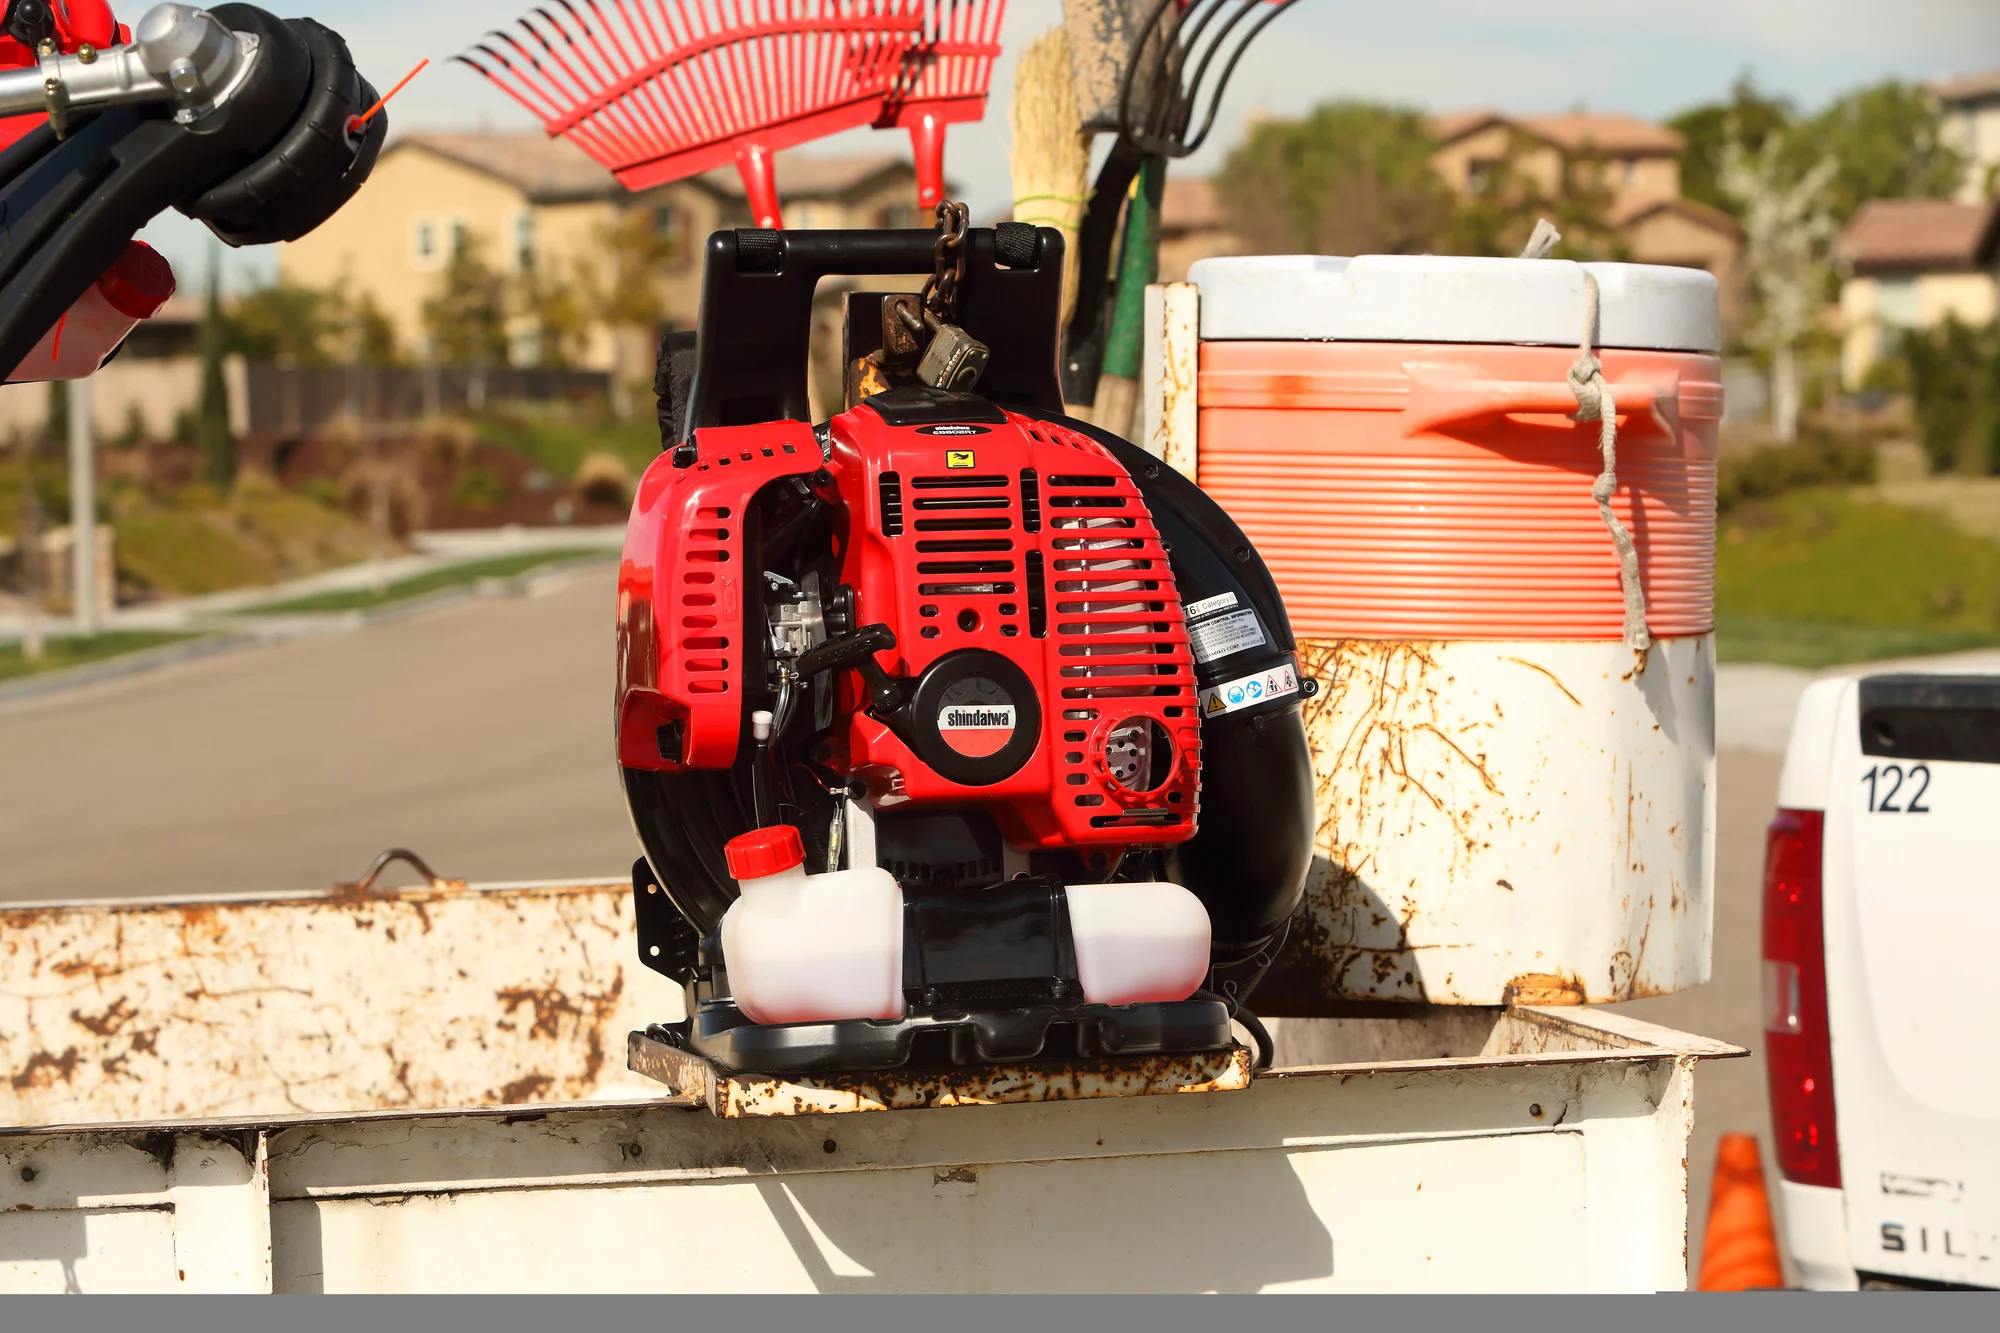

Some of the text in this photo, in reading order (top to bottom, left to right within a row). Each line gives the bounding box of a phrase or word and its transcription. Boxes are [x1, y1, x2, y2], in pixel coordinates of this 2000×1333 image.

[1202, 598, 1229, 609] Category
[1211, 616, 1229, 625] CONTROL
[947, 709, 1009, 727] shindaiwa
[1861, 764, 1930, 812] 122
